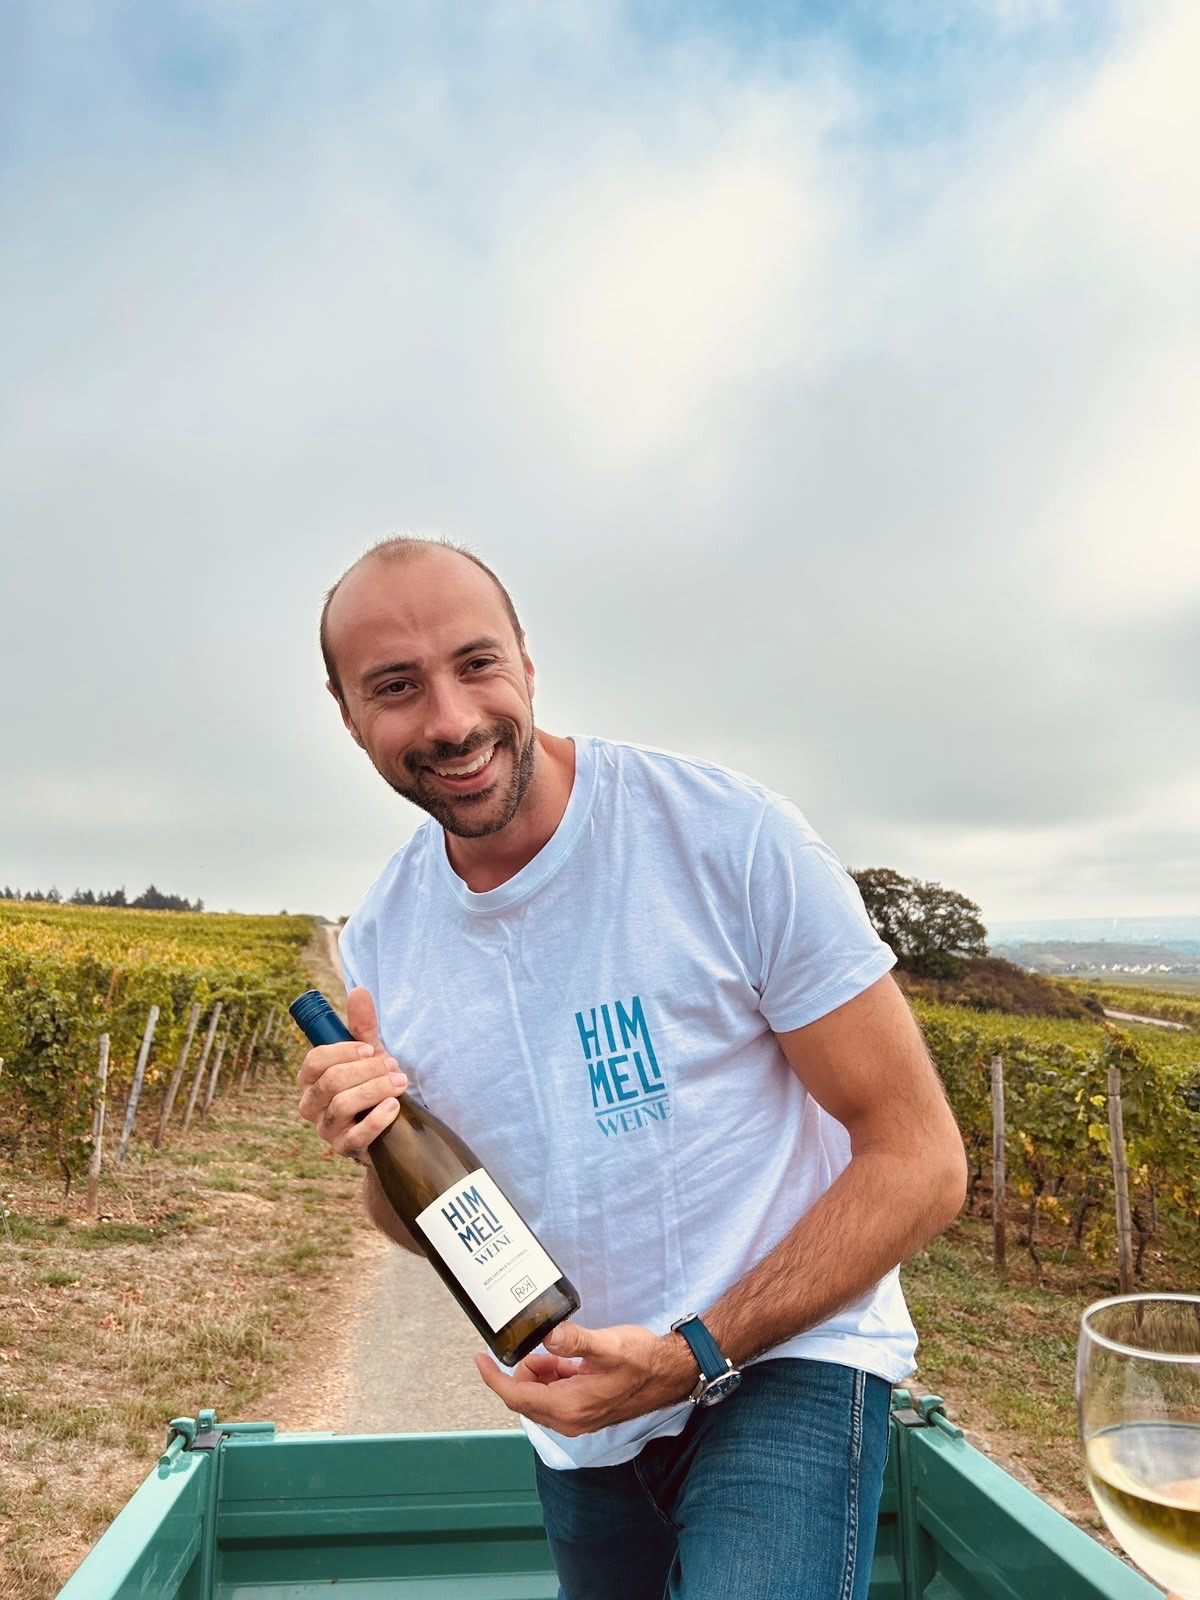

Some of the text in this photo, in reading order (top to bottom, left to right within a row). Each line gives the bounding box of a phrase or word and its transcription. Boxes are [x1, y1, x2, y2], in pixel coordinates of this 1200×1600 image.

[575, 996, 662, 1079] HIM
[588, 1051, 666, 1108] MEL
[596, 1099, 673, 1137] WEINE
[441, 1185, 500, 1231] HIM
[457, 1213, 503, 1253] MEL
[474, 1231, 514, 1265] WEINE
